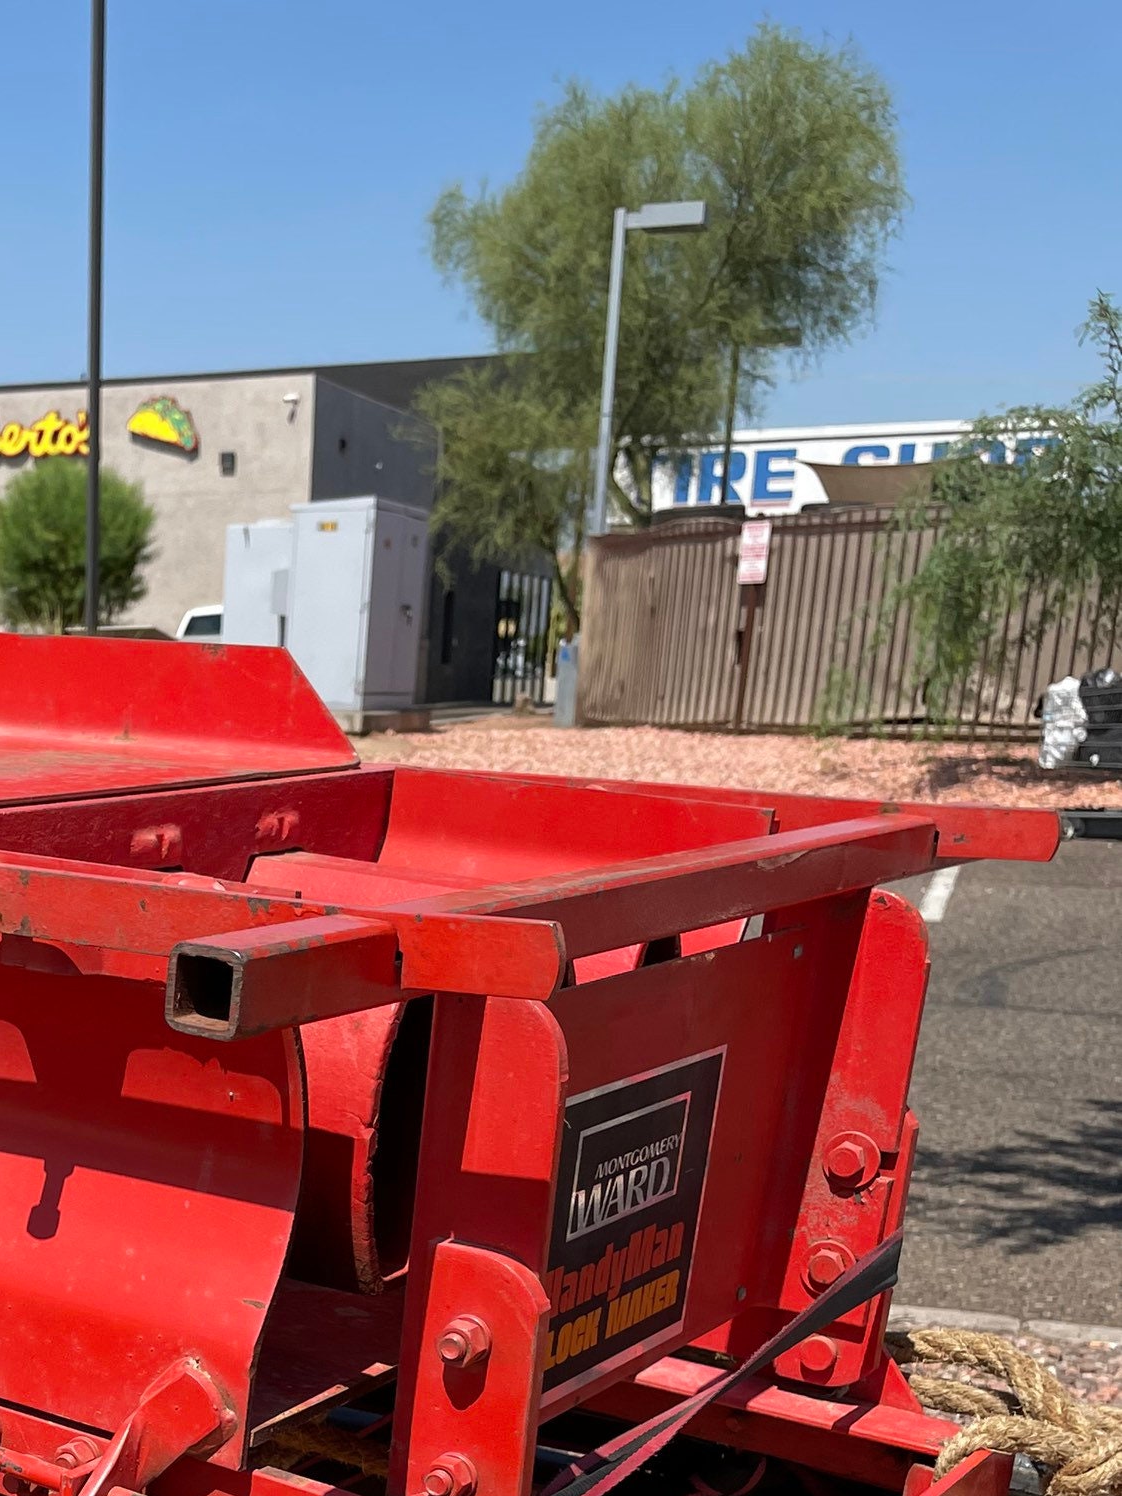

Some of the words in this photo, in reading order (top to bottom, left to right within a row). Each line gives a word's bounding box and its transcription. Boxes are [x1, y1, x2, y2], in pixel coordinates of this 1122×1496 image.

[571, 1156, 671, 1234] WARD
[595, 1132, 683, 1180] MONTGOMERY
[543, 1307, 603, 1371] LOCK
[605, 1269, 680, 1340] MAKER
